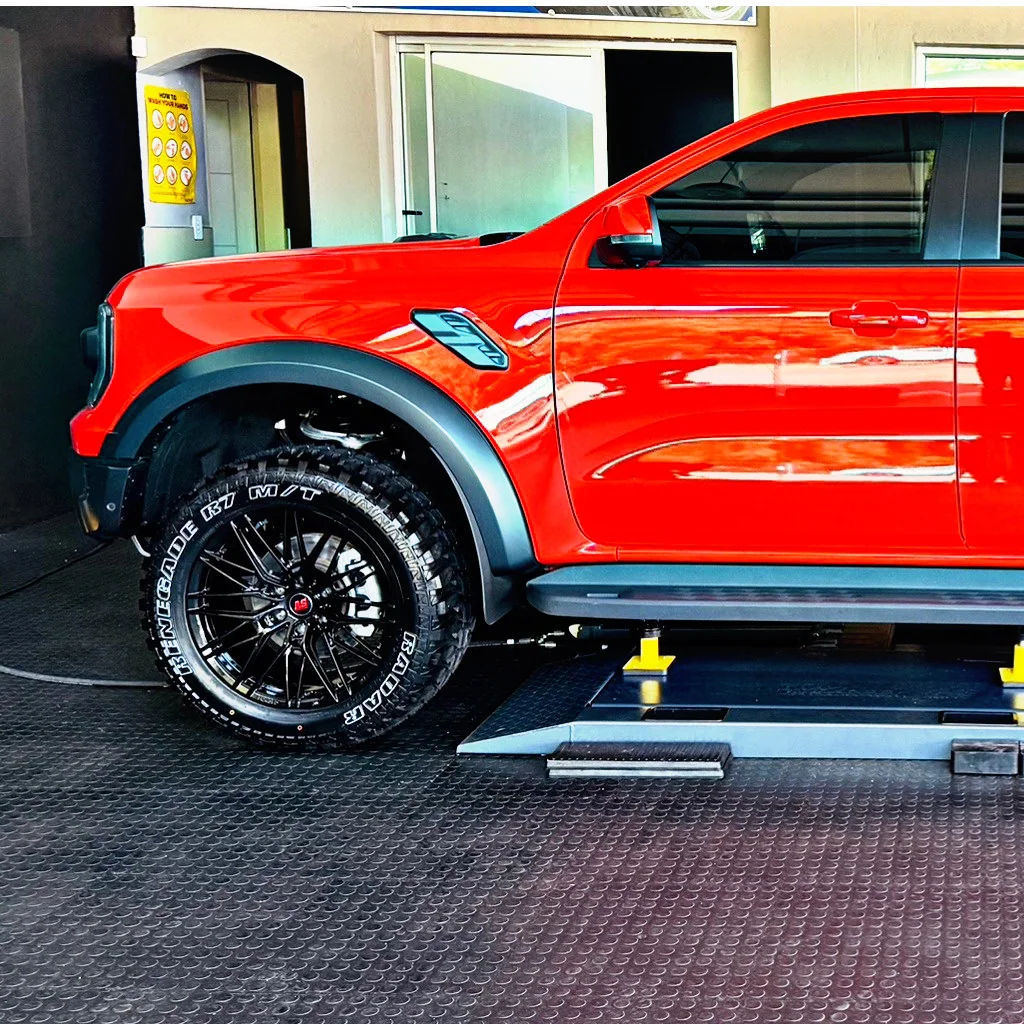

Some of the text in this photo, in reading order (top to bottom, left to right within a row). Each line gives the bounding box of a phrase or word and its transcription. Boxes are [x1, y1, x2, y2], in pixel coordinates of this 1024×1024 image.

[153, 483, 322, 676] RENEGADE R7 M/T
[343, 631, 418, 725] RADAR
